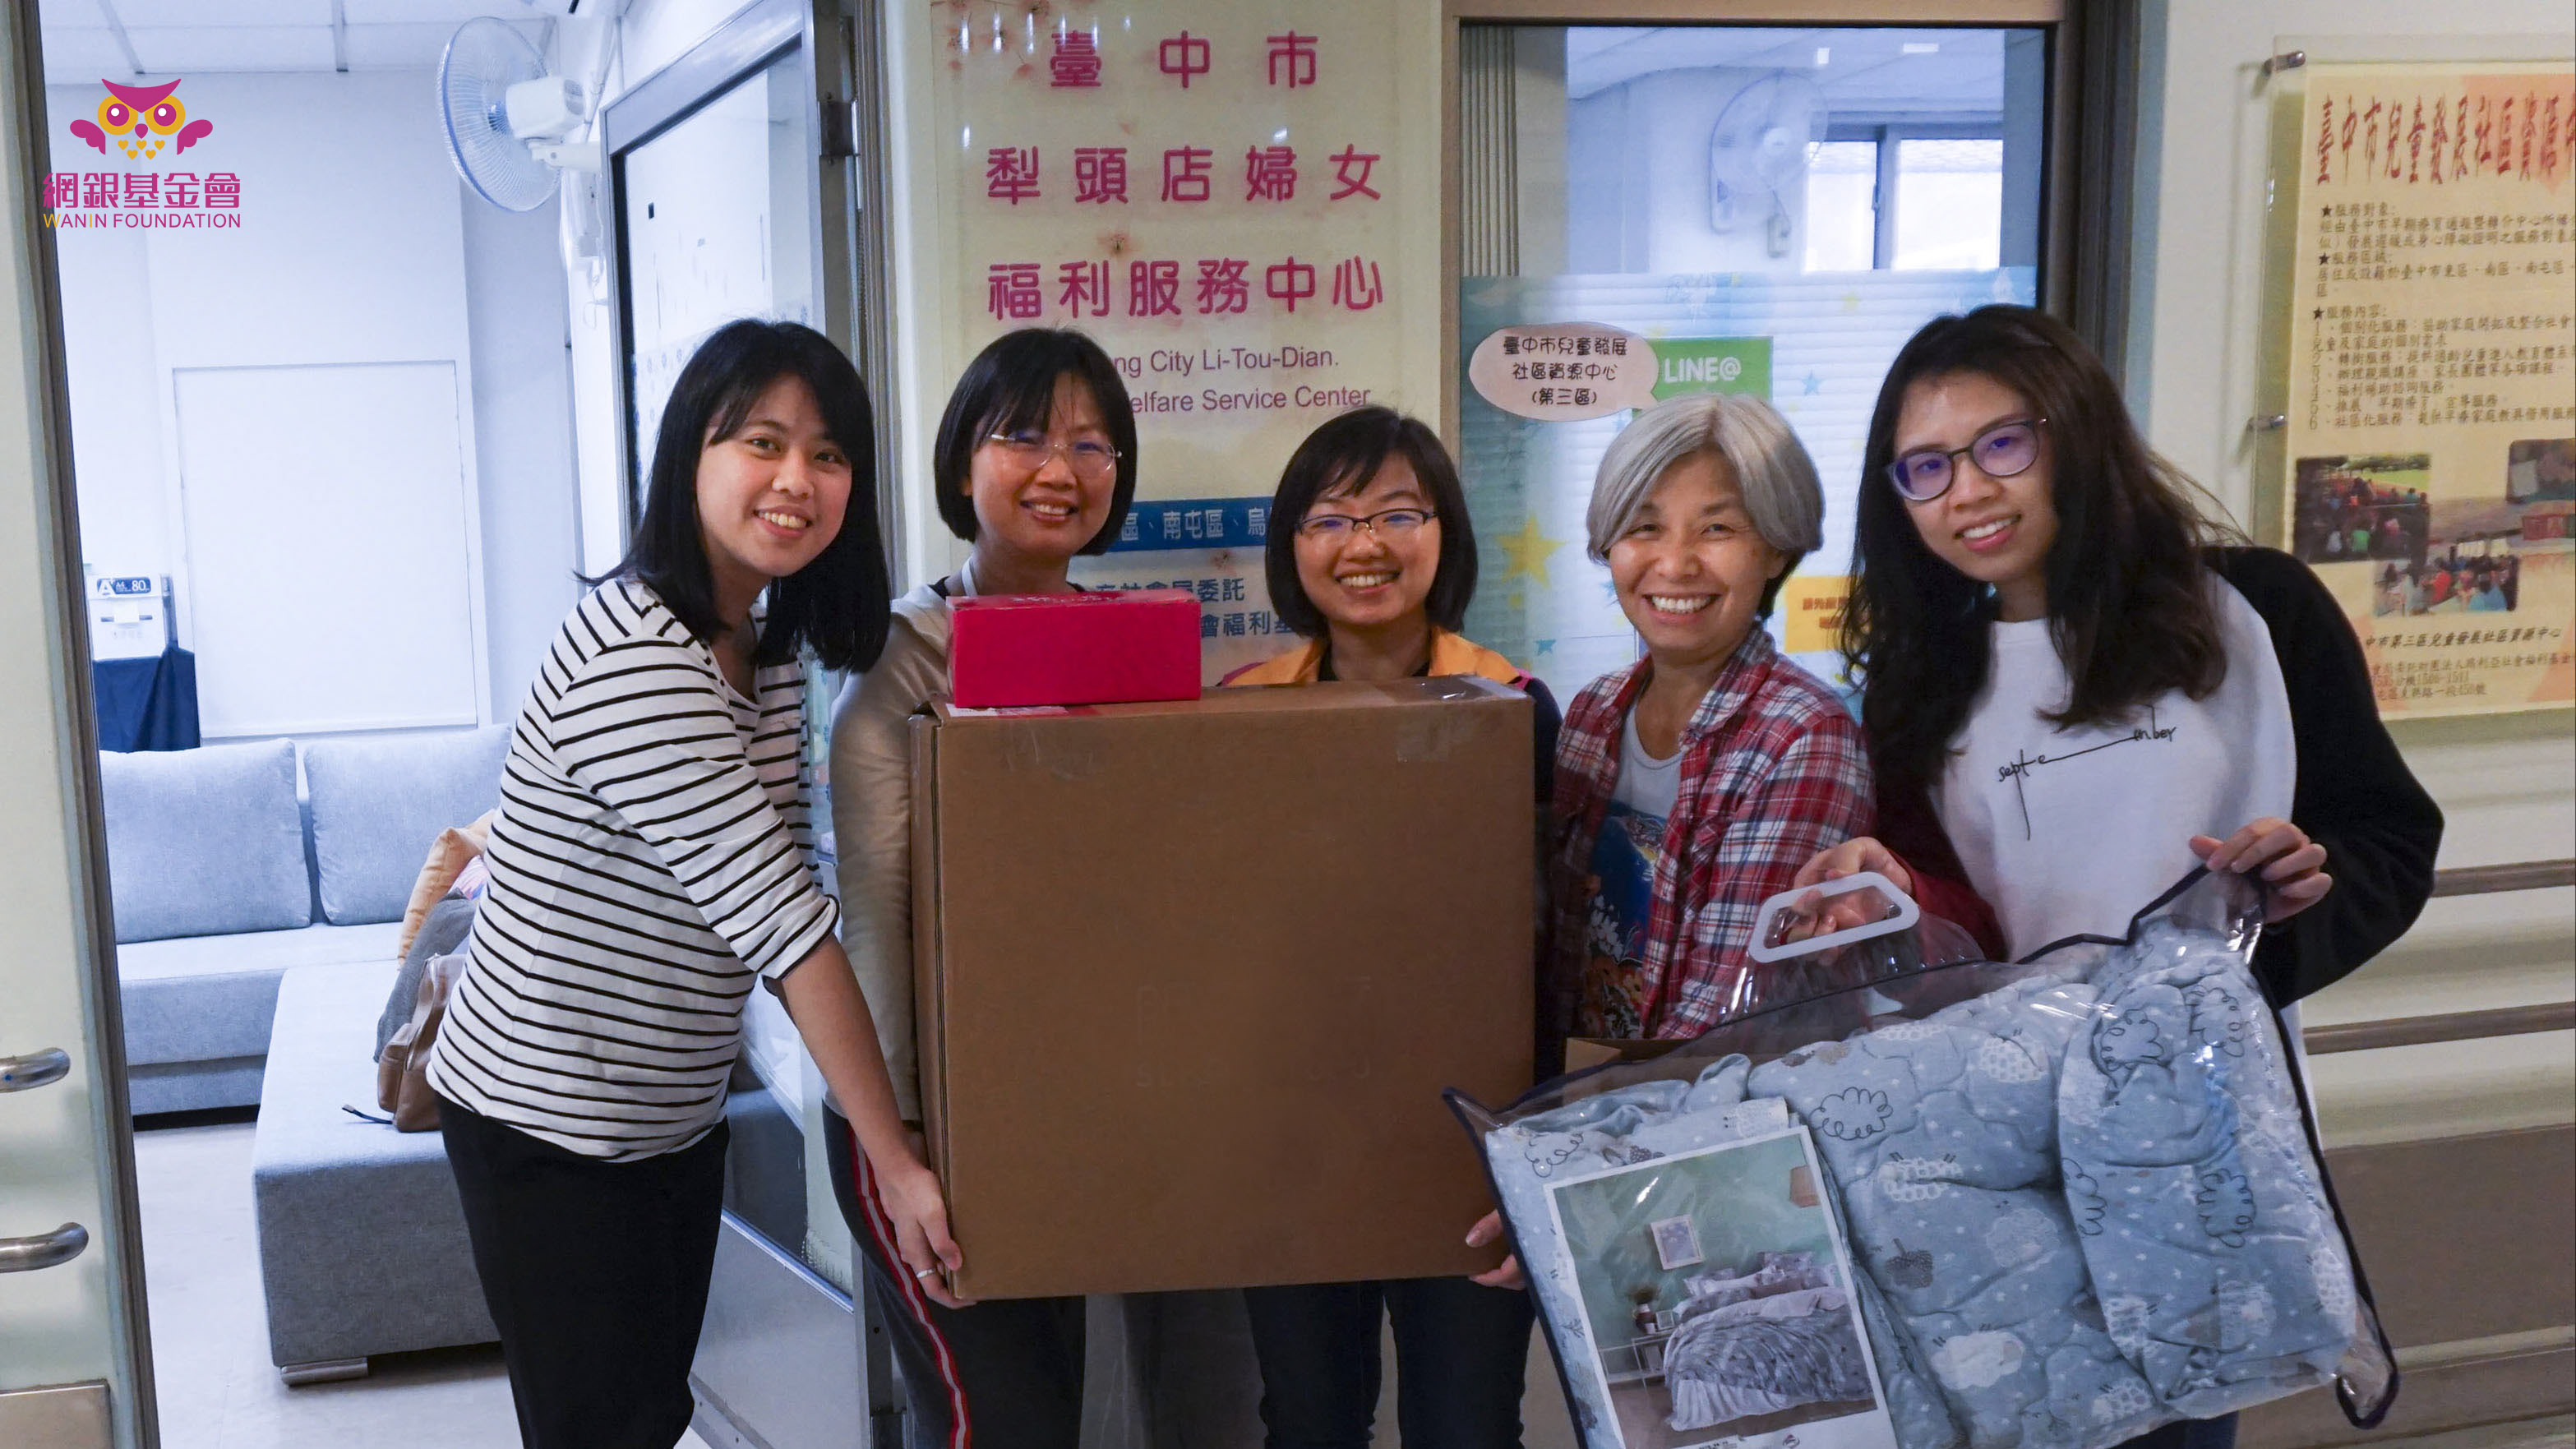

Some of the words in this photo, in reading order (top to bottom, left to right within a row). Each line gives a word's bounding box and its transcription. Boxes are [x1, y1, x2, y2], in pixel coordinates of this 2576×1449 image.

[1050, 30, 1318, 89] 臺中市
[986, 143, 1382, 205] 犁頭店婦女
[988, 256, 1384, 321] 福利服務中心
[1503, 336, 1627, 356] 臺中市兒童發展
[1151, 348, 1194, 376] City
[1512, 362, 1618, 381] 社區資源中心
[1664, 356, 1742, 384] LINE@
[1203, 388, 1286, 410] Service
[1295, 385, 1371, 408] Center
[1532, 387, 1597, 406] (第三區)
[132, 579, 146, 592] 80
